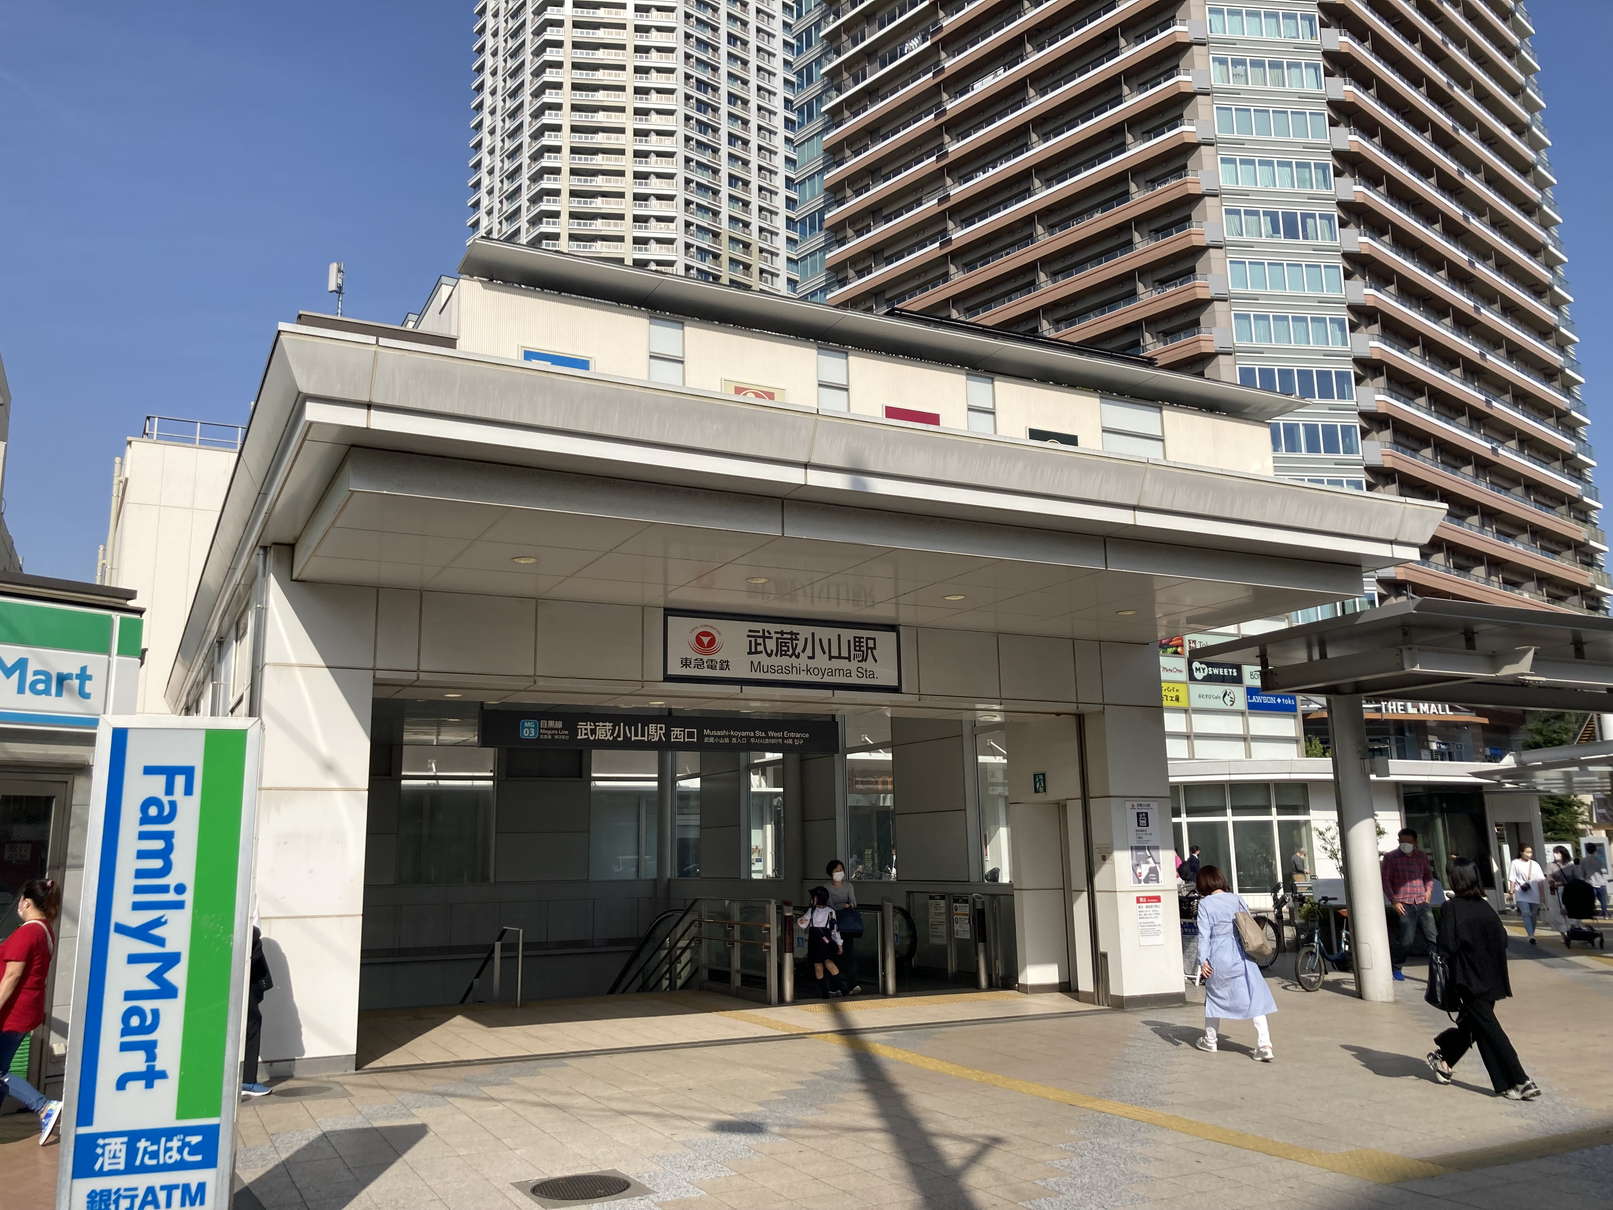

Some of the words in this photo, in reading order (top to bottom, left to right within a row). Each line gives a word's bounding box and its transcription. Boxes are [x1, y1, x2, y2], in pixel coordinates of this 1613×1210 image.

[746, 628, 878, 664] 武蔵小山駅
[680, 657, 730, 671] 東急電鉄
[750, 660, 852, 680] Musashi-koyama
[856, 667, 879, 679] Sta.
[1208, 667, 1238, 676] SWEETS
[1248, 695, 1276, 704] LAWSON
[1380, 701, 1405, 714] THE
[1419, 703, 1454, 715] MALL
[523, 728, 535, 736] 03
[576, 721, 666, 742] 武蔵小山駅
[670, 727, 697, 742] 西口
[703, 729, 754, 738] Musashi-koyama
[113, 765, 196, 1093] FamilyMart
[93, 1136, 128, 1172] 酒
[135, 1134, 203, 1167] たばこ
[86, 1181, 208, 1210] 銀行ATM
